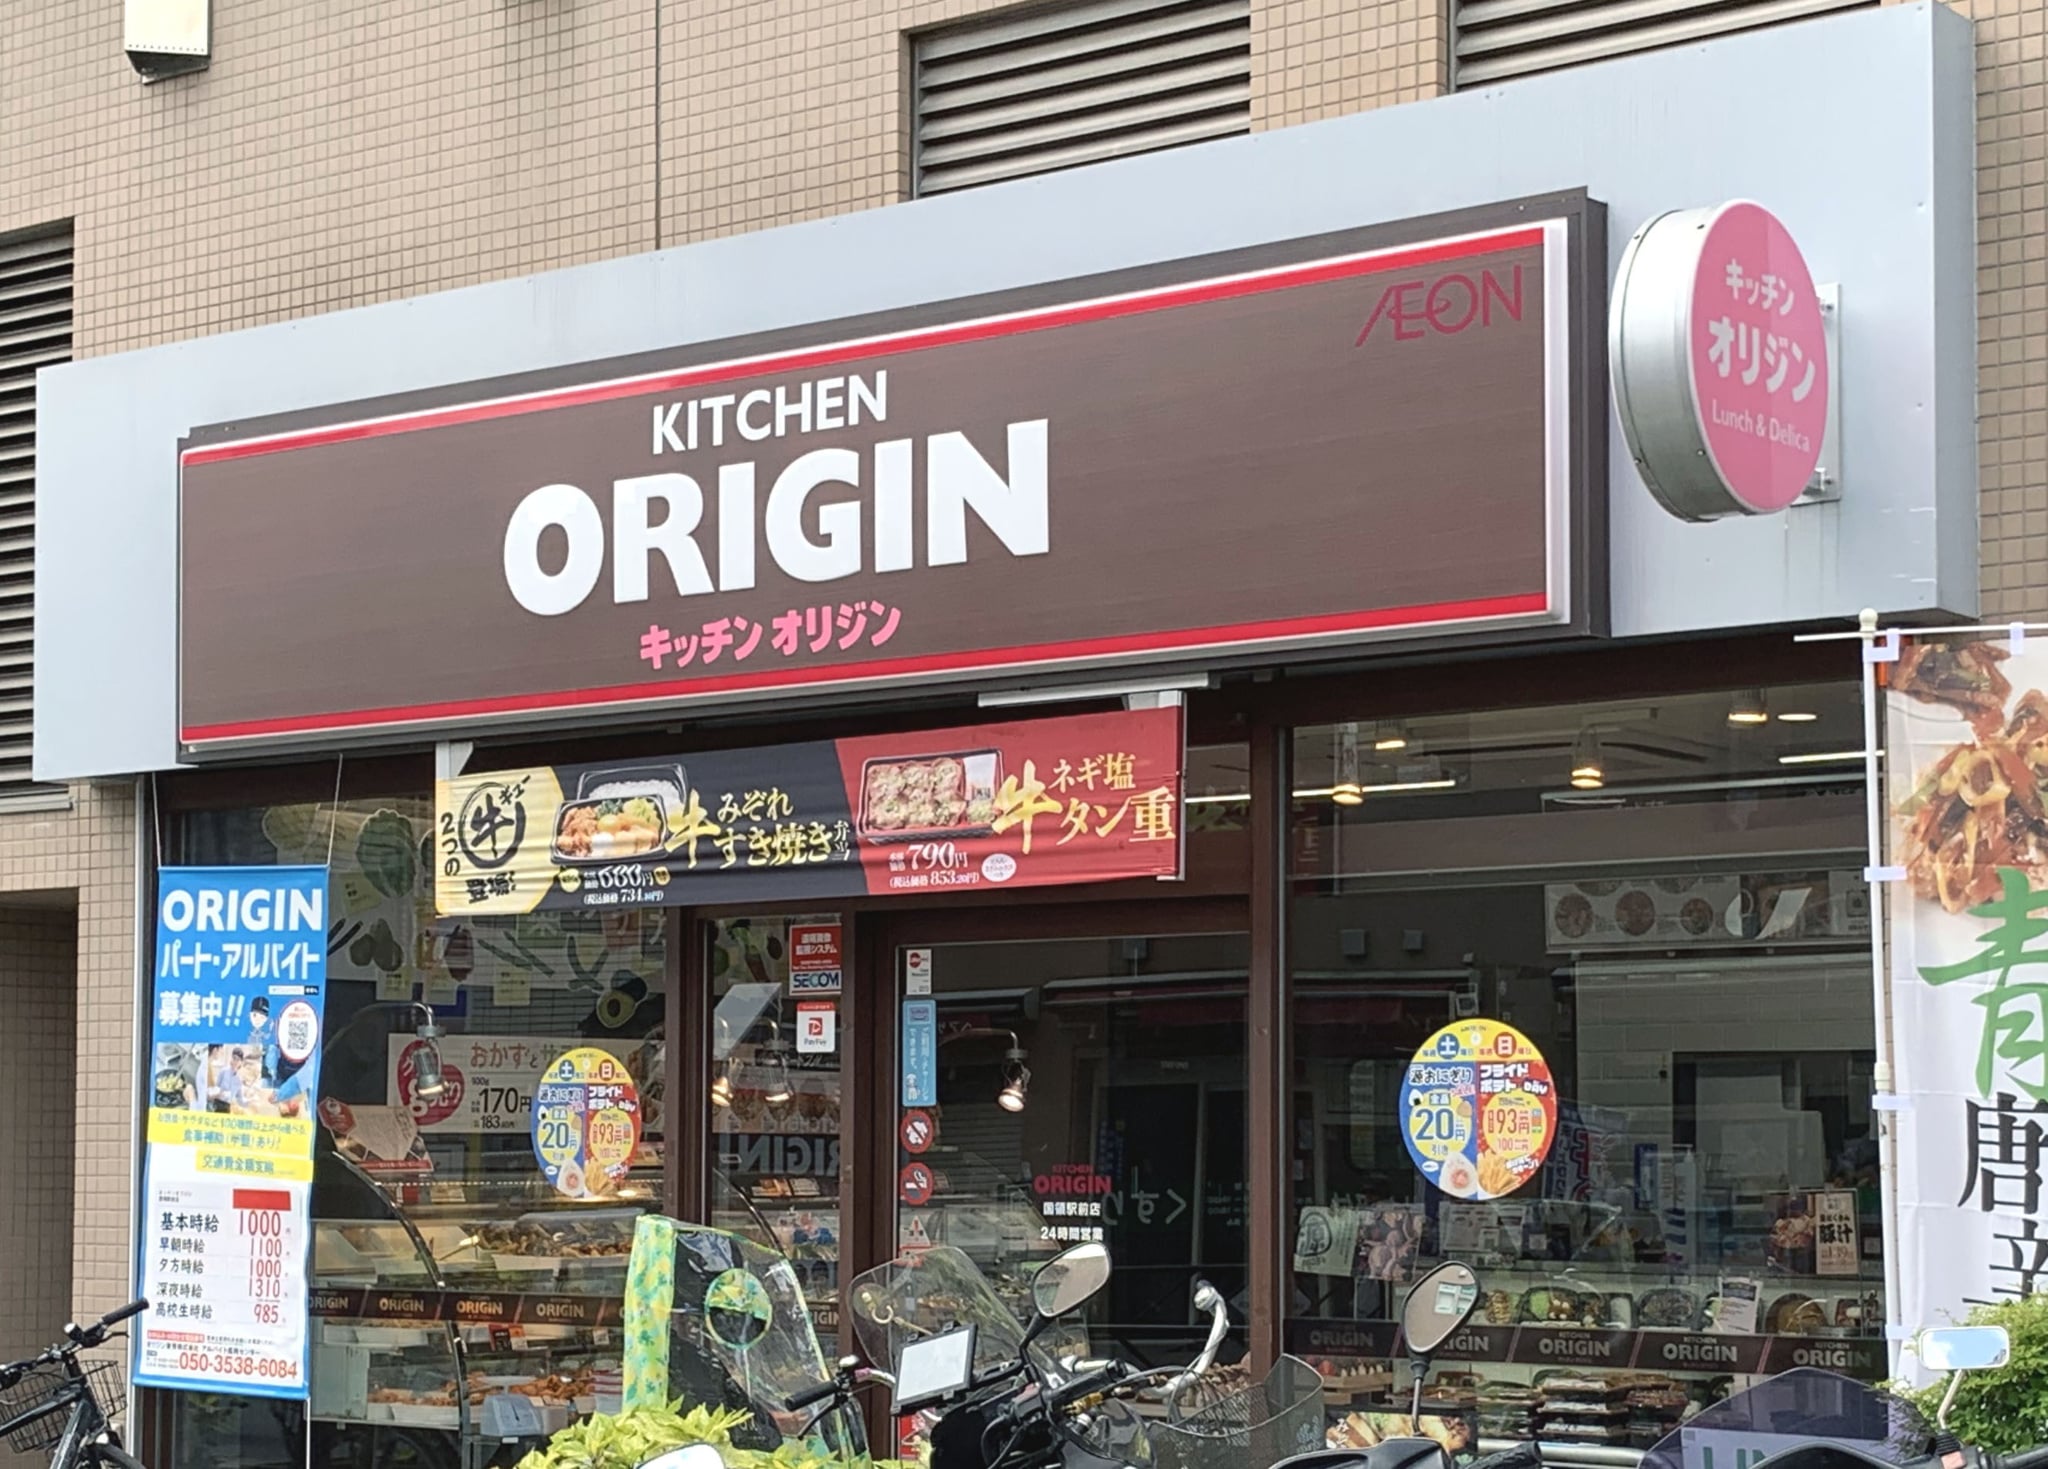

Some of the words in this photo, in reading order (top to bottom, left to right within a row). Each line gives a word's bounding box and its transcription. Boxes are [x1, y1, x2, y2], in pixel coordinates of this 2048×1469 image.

[1726, 258, 1795, 317] キッチン
[1708, 316, 1816, 403] オリジン
[652, 370, 887, 455] KITCHEN
[1711, 400, 1753, 436] Lunch
[1756, 416, 1768, 438] &
[1769, 420, 1811, 453] Delica
[503, 418, 1050, 616] ORIGIN
[639, 615, 763, 670] キッチン
[771, 600, 902, 656] オリジン
[1048, 752, 1137, 793] ネギ塩
[716, 787, 794, 824] みぞれ
[992, 759, 1063, 855] 牛
[1055, 786, 1177, 846] タン重
[470, 793, 514, 858] 牛
[664, 788, 721, 870] 牛
[440, 811, 461, 877] 2つの
[713, 821, 833, 869] すき焼き
[831, 820, 851, 861] 弁当
[907, 842, 969, 871] 790円
[162, 888, 322, 932] ORIGIN
[160, 938, 320, 980] パート・アルバイト
[793, 972, 839, 988] SECOM
[159, 990, 245, 1028] 募集中!!
[1480, 1063, 1529, 1079] フライド
[588, 1086, 623, 1098] フライド
[1480, 1079, 1516, 1094] ポテト
[1523, 1080, 1548, 1095] DAY
[479, 1087, 532, 1114] 170円
[1033, 1175, 1114, 1195] ORIGIN
[1042, 1201, 1102, 1217] 国領駅前店
[160, 1211, 220, 1233] 基本時給
[239, 1210, 281, 1236] 1000
[1040, 1226, 1105, 1241] 24時間営業
[1819, 1223, 1853, 1244] 豚汁
[159, 1236, 206, 1254] 早朝時給
[159, 1258, 204, 1275] 夕方時給
[156, 1282, 203, 1299] 深夜時給
[155, 1302, 213, 1320] 高校生時給
[254, 1303, 279, 1324] 985
[379, 1296, 425, 1312] ORIGIN
[455, 1299, 503, 1315] ORIGIN
[535, 1303, 585, 1318] ORIGIN
[1309, 1328, 1375, 1347] ORIGIN
[1538, 1338, 1610, 1356] ORIGIN
[1558, 1331, 1591, 1339] KITCHEN
[1683, 1336, 1718, 1344] KITCHEN
[1814, 1341, 1850, 1349] KITCHEN
[1662, 1343, 1738, 1362] ORIGIN
[1792, 1348, 1872, 1368] ORIGIN
[179, 1352, 298, 1378] 050-3538-6084
